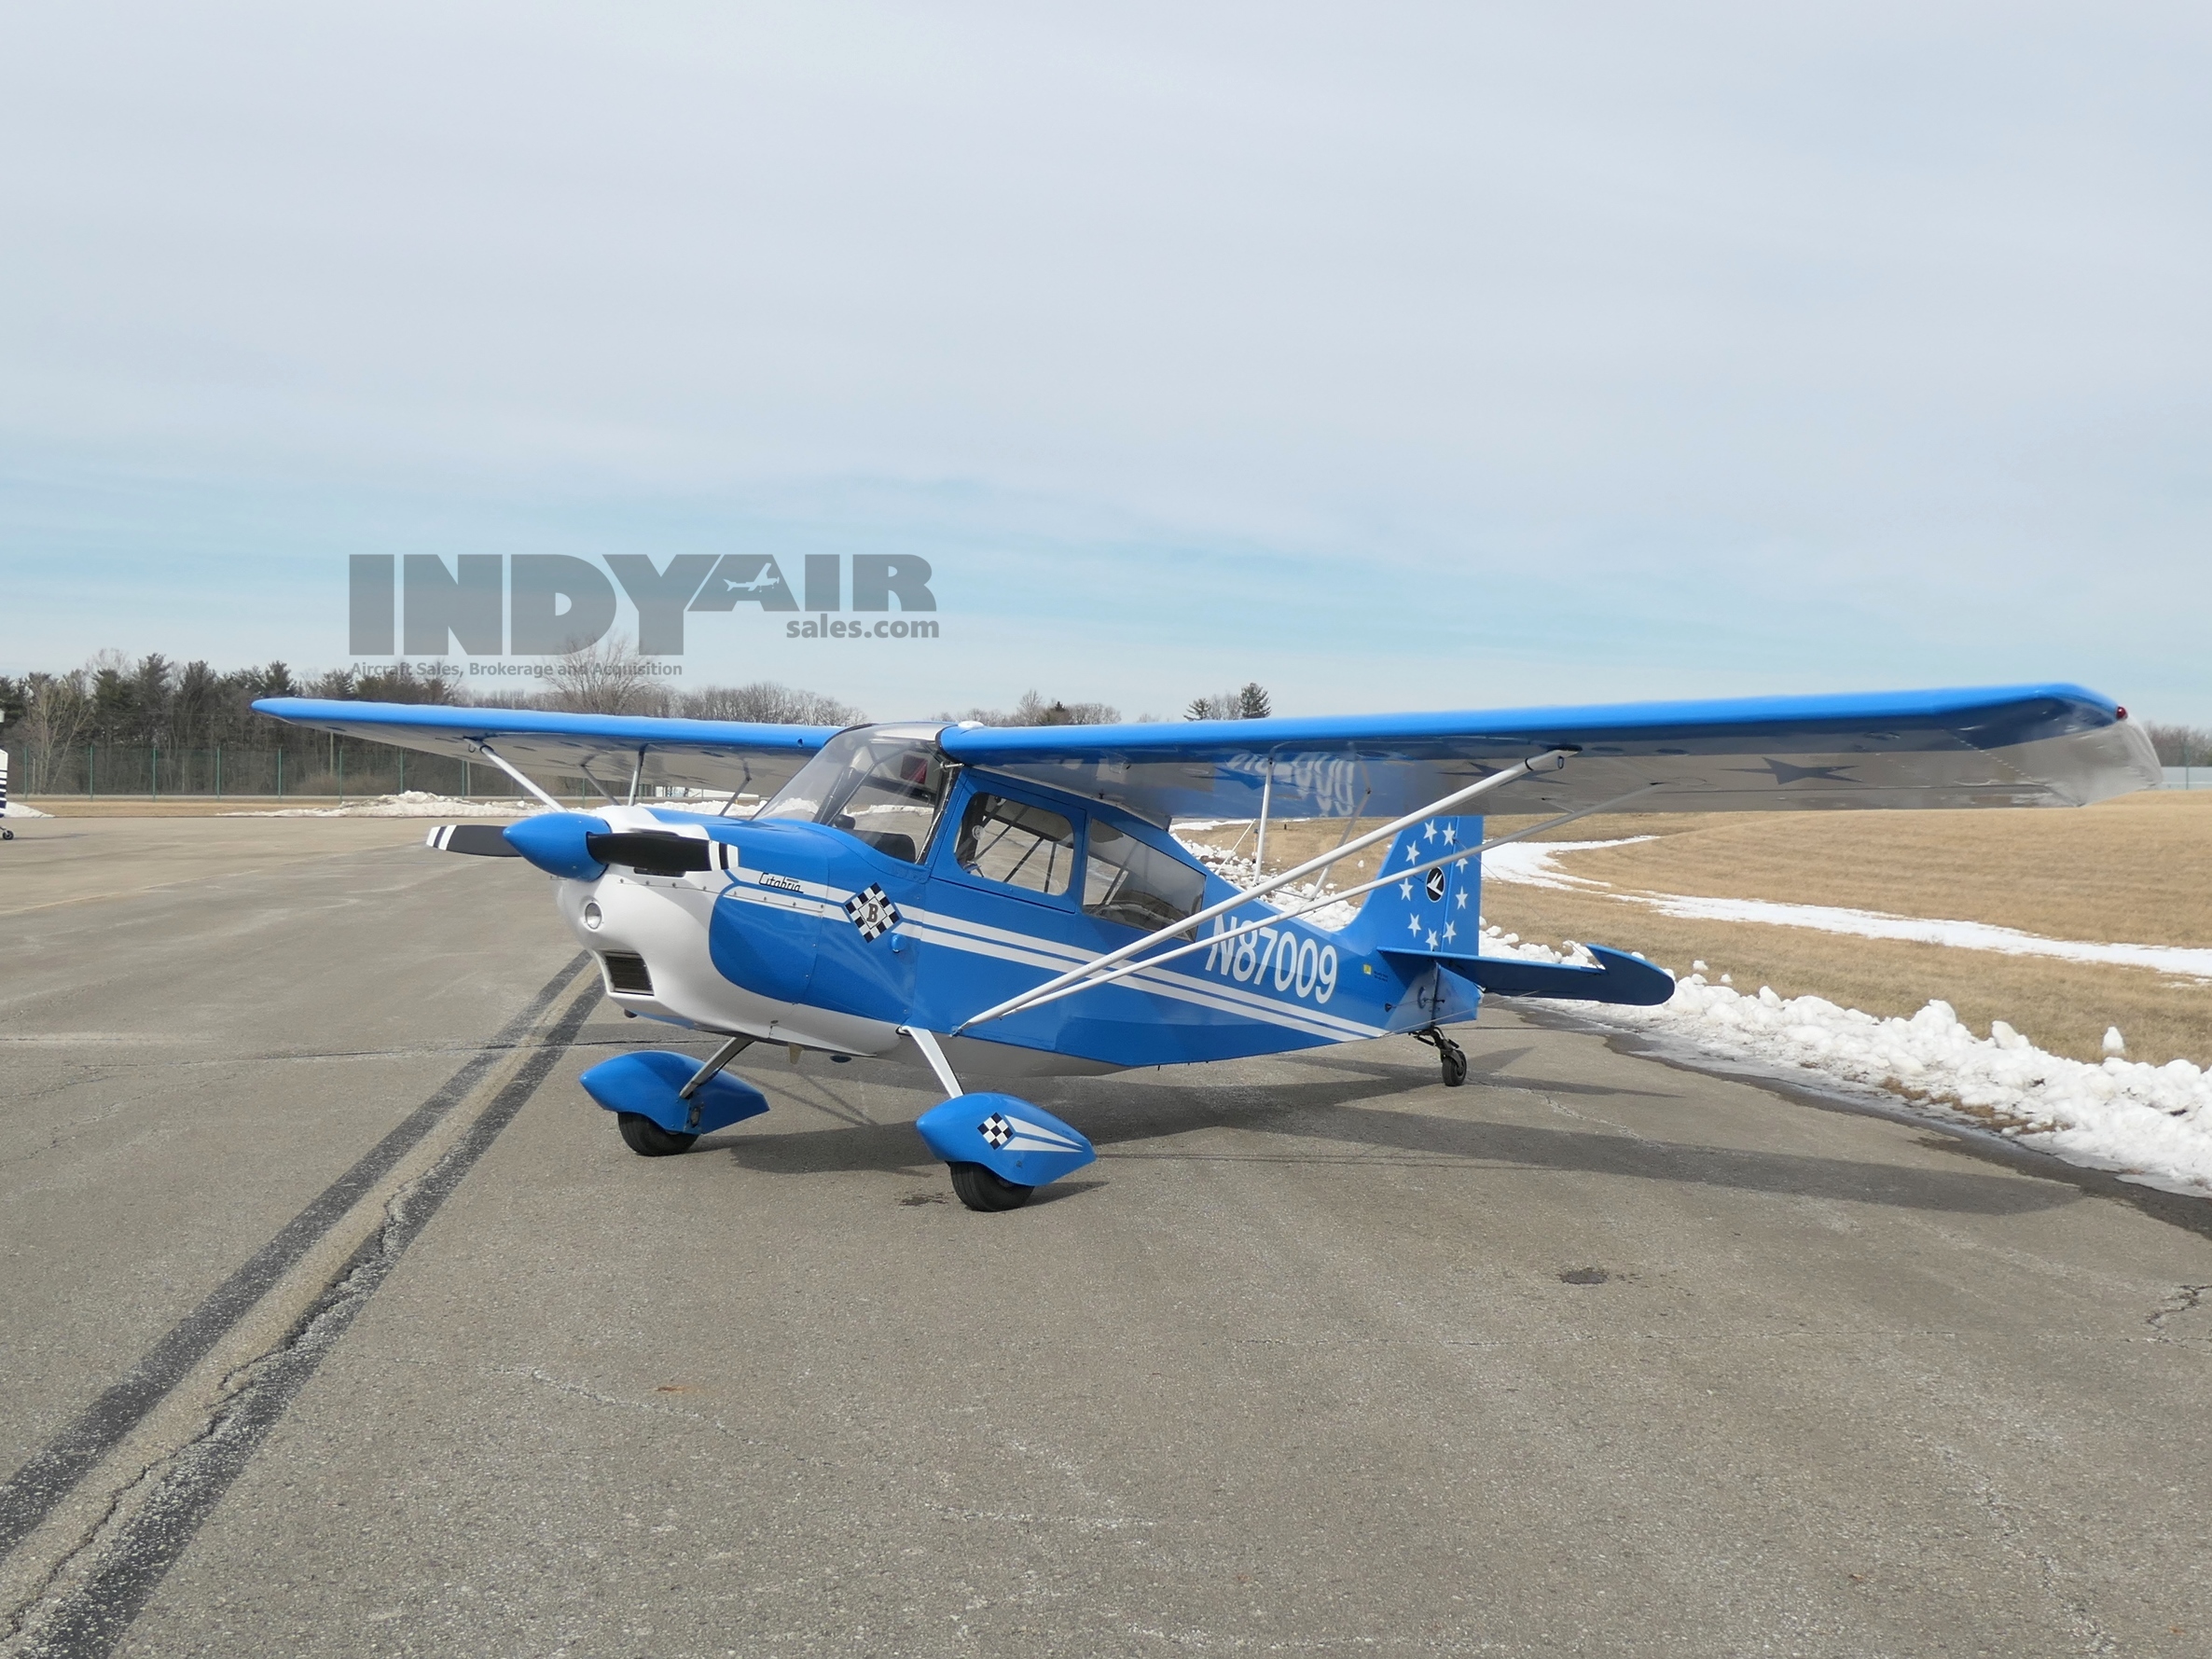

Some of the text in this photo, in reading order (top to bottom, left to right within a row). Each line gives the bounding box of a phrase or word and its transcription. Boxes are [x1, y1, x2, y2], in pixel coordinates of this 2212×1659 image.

[758, 872, 804, 893] Citabria
[866, 903, 879, 923] B
[1205, 913, 1338, 1004] N87009
